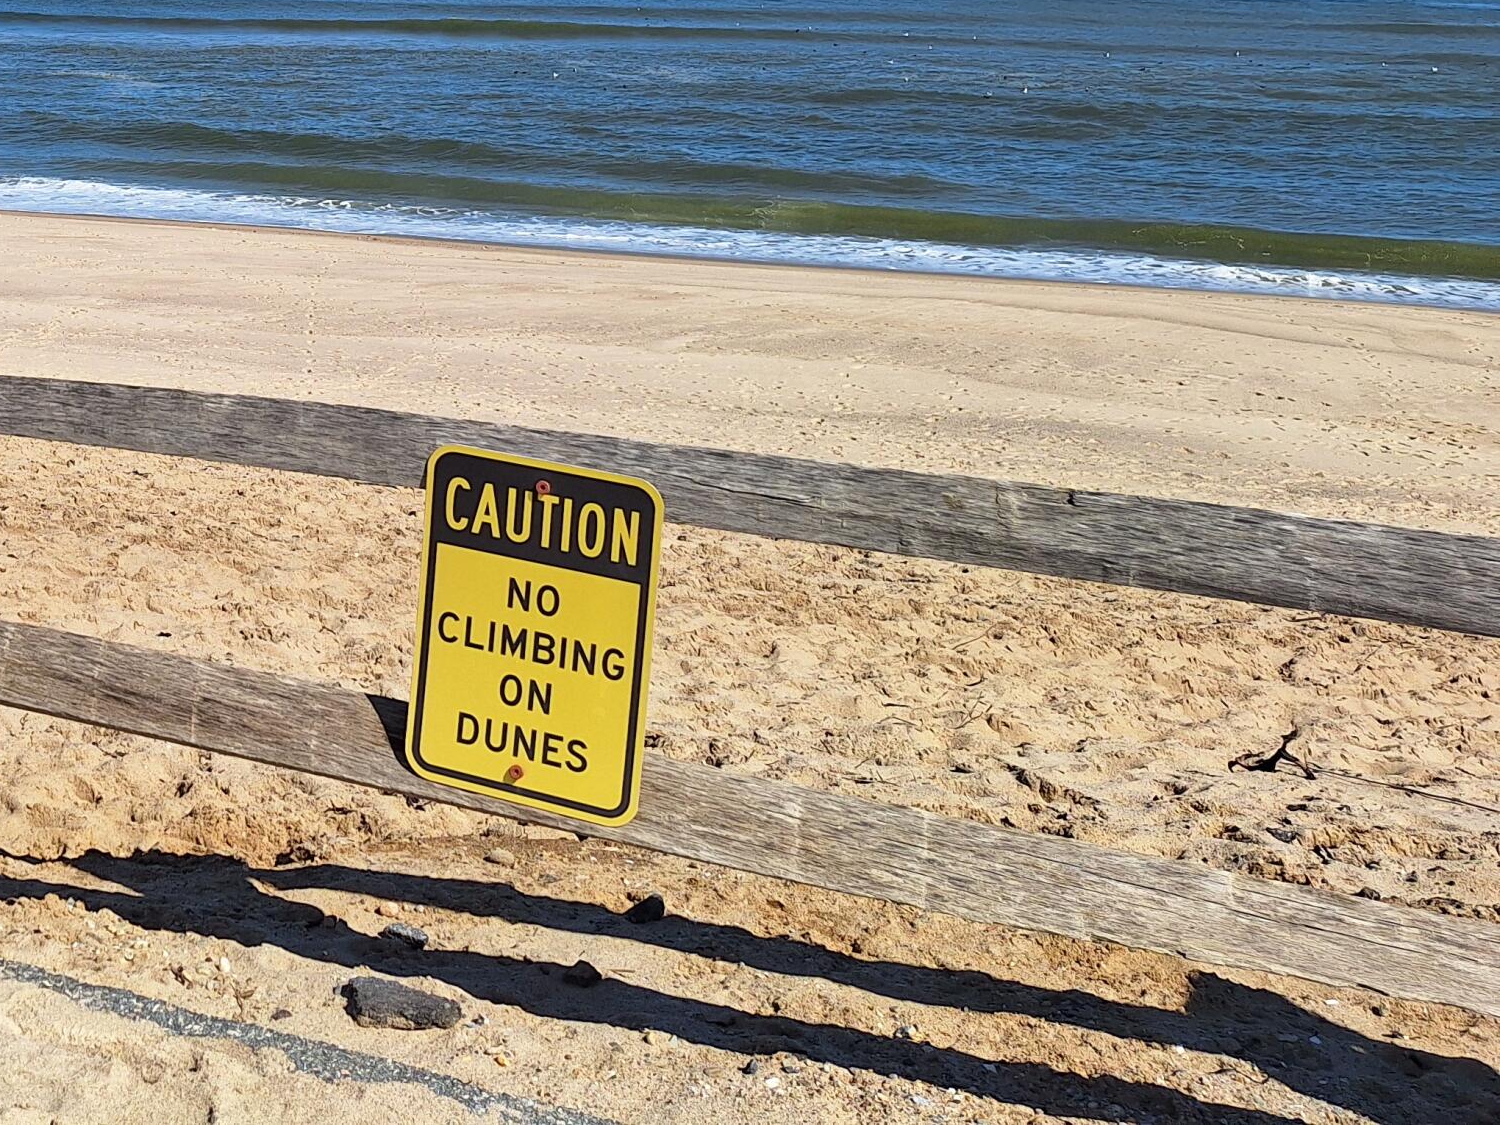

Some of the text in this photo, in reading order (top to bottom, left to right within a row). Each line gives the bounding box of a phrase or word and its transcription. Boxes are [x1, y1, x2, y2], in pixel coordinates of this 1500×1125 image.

[445, 476, 640, 566] CAUTION
[507, 577, 561, 617] NO
[438, 611, 625, 681] CLIMBING
[499, 674, 552, 715] ON
[456, 712, 589, 773] DUNES
